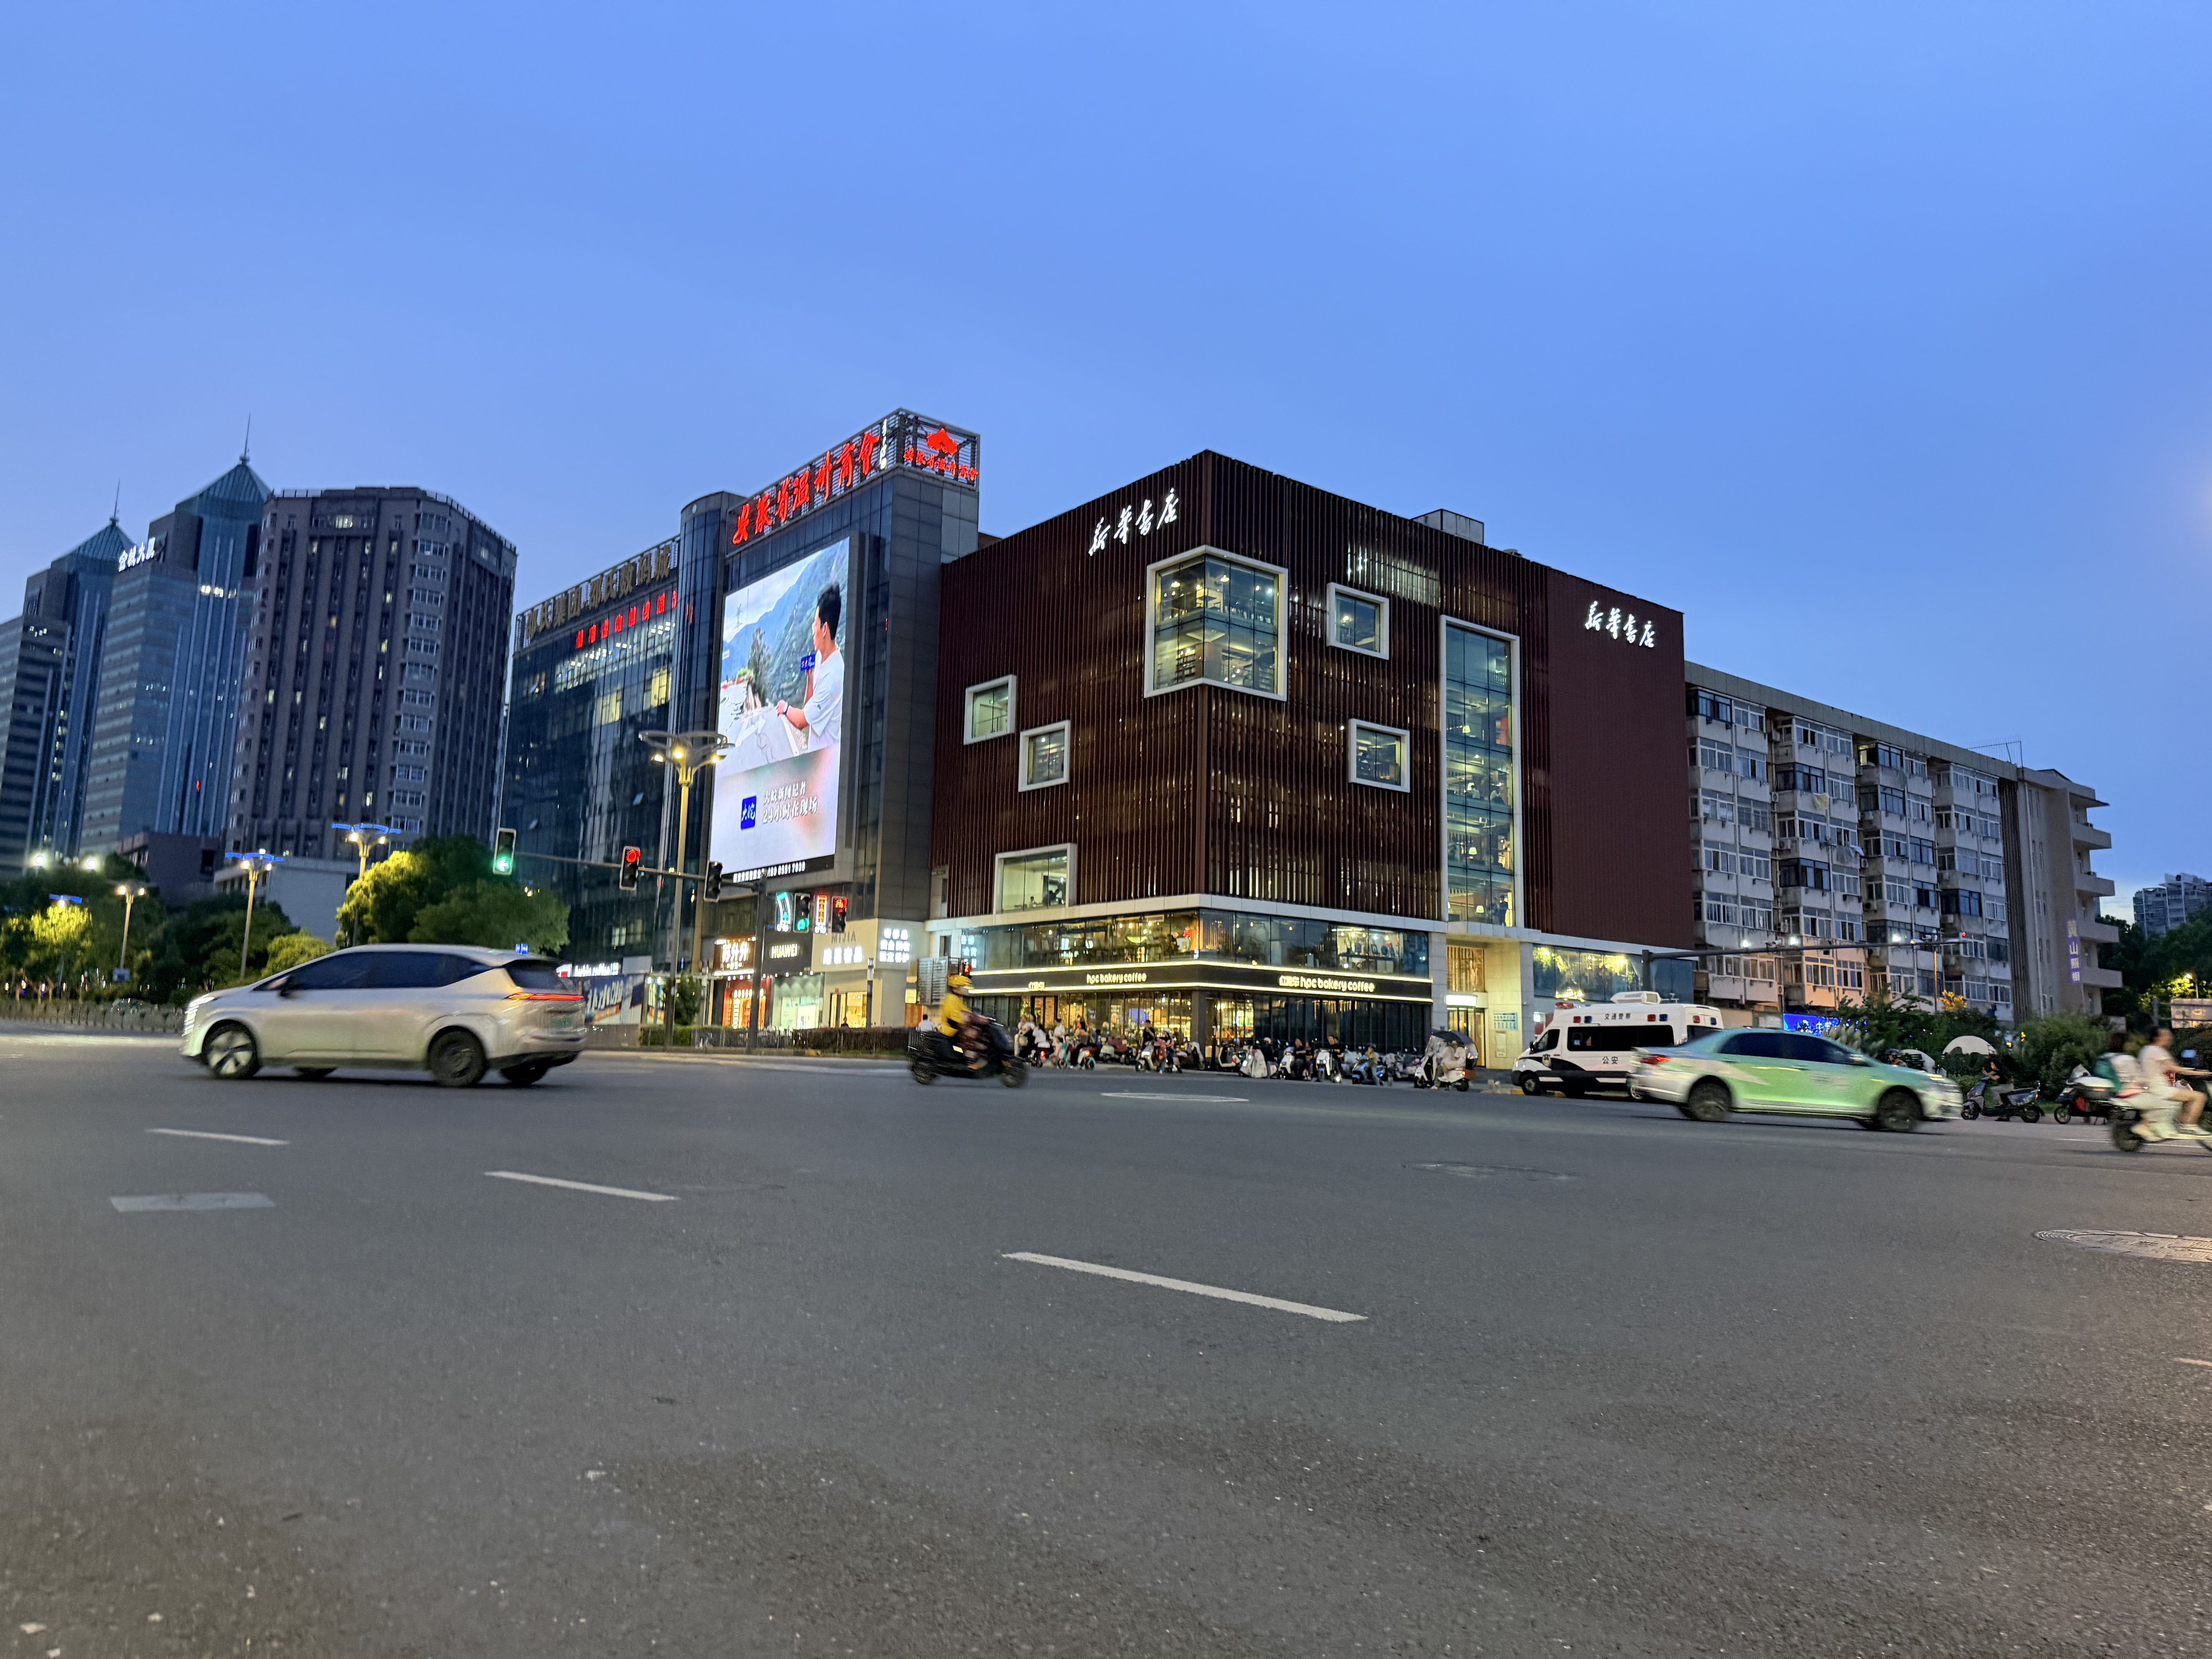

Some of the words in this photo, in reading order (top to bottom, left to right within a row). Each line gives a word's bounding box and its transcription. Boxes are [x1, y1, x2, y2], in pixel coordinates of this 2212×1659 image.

[763, 796, 817, 824] 24小时在现场
[832, 931, 856, 944] MIJIA
[771, 944, 798, 958] HUAWEI
[1087, 974, 1099, 984] hpc
[1100, 973, 1123, 984] bakery
[1124, 972, 1147, 982] coffee
[1300, 976, 1317, 989] hpc
[1317, 978, 1347, 991] bakery
[1348, 981, 1375, 993] coffee
[1602, 1056, 1618, 1065] 公安
